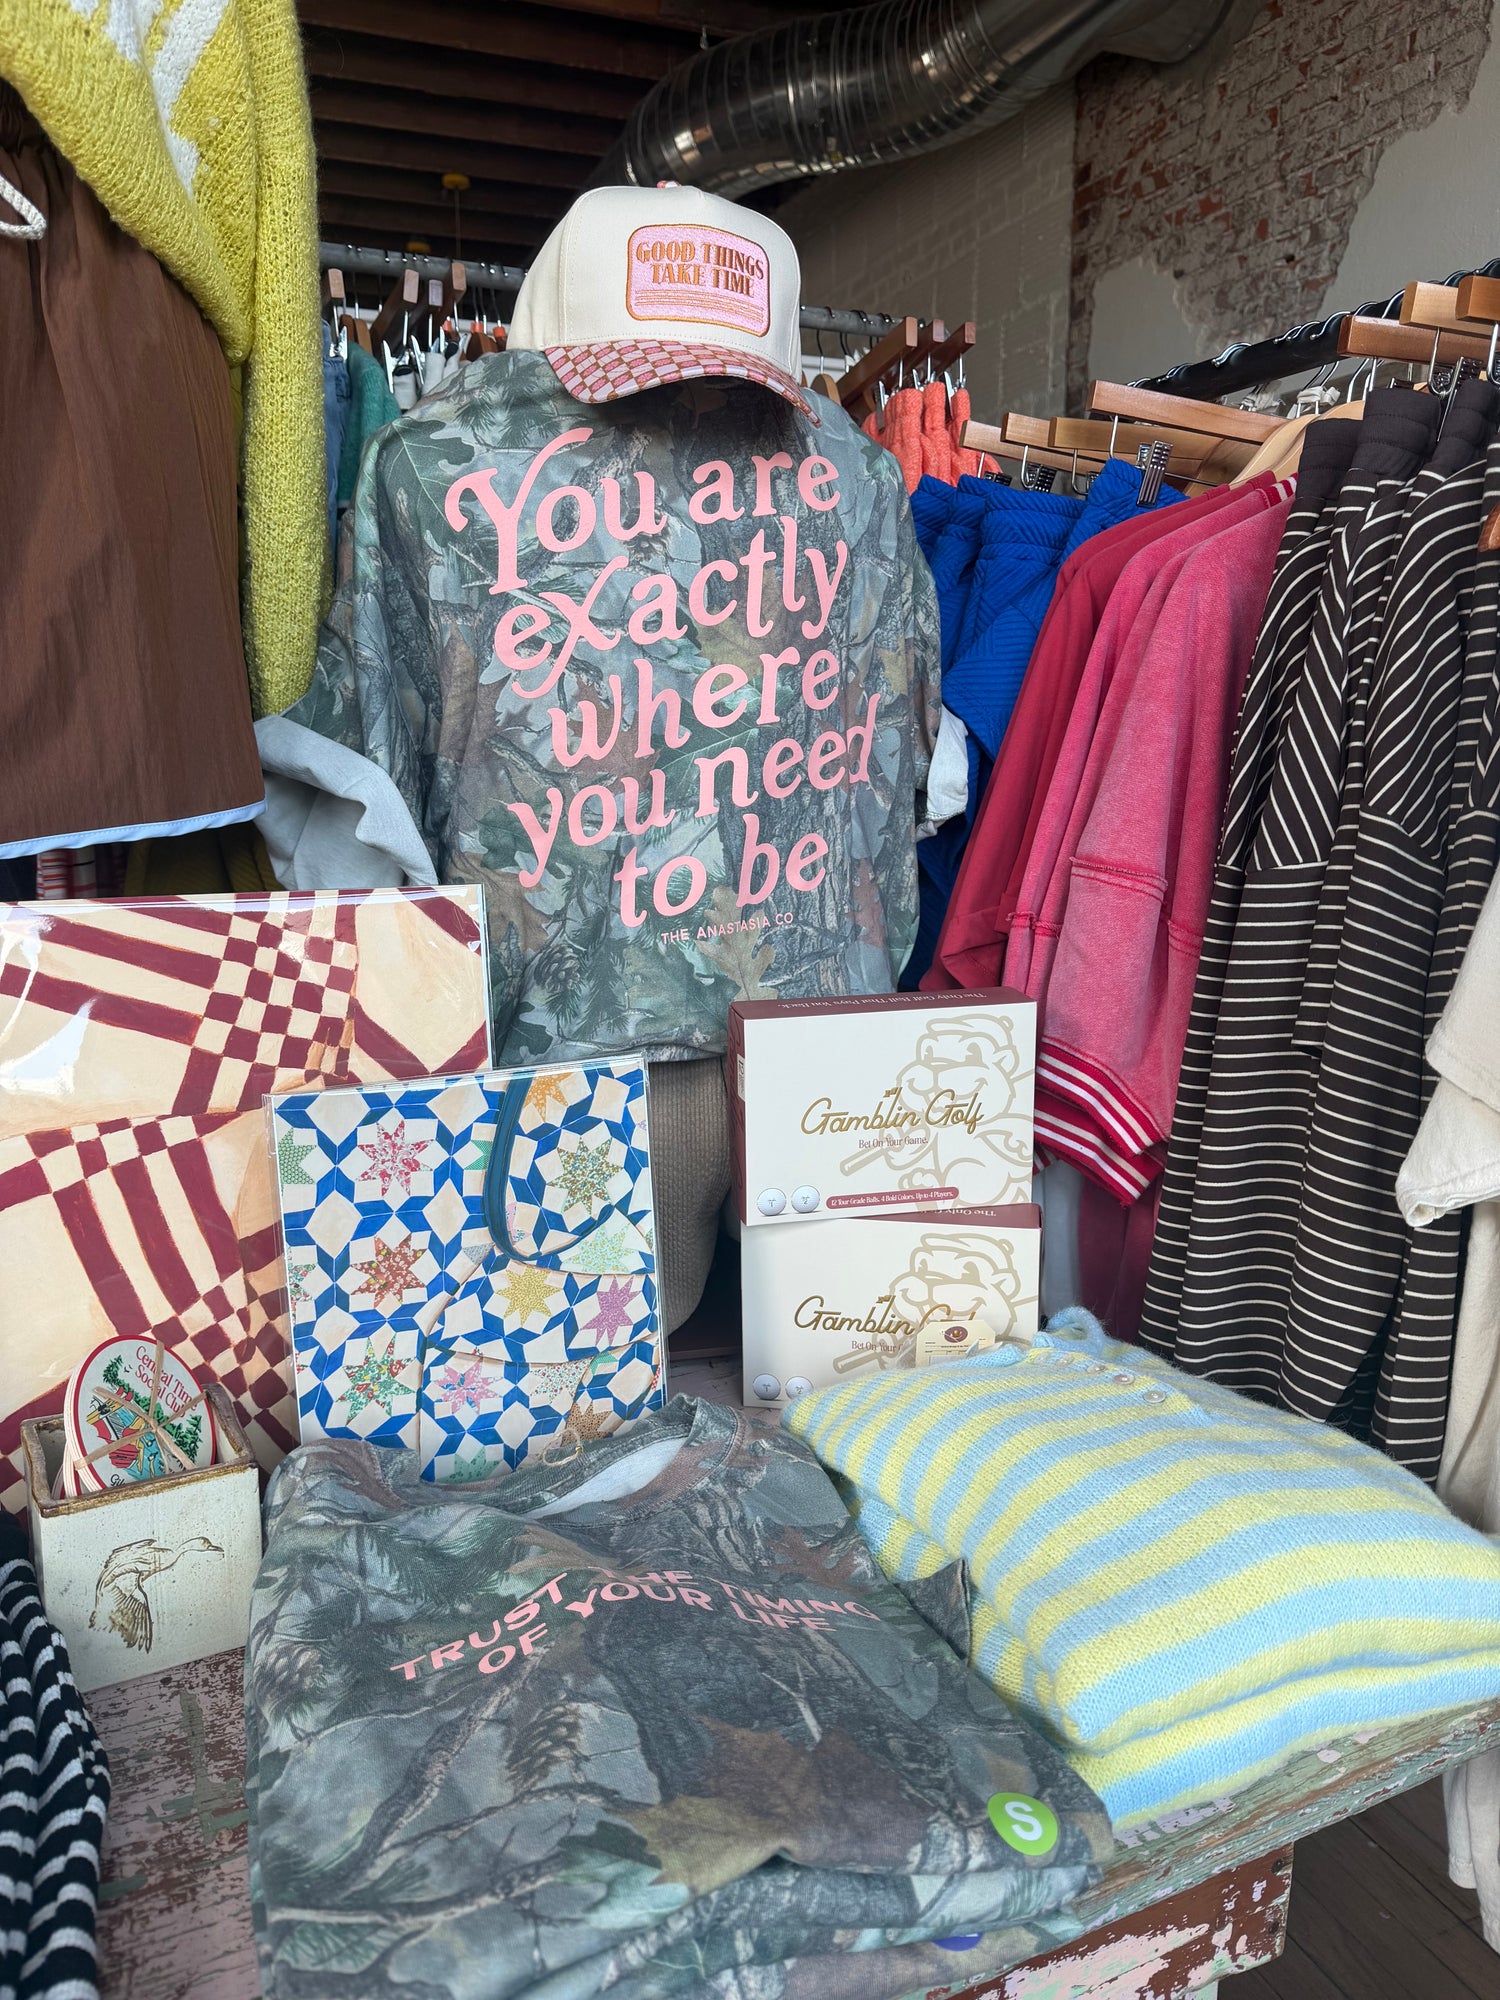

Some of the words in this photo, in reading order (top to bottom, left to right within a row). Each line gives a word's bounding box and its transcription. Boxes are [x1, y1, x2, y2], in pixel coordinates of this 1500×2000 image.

[636, 241, 696, 264] GOOD
[702, 243, 764, 280] THINGS
[650, 263, 706, 286] TAKE
[712, 268, 755, 298] TIME
[445, 427, 669, 595] You
[687, 451, 841, 525] are
[494, 515, 848, 699] exactly
[547, 646, 840, 767] where
[507, 768, 676, 888] you
[694, 694, 880, 819] need
[613, 846, 707, 927] to
[736, 813, 829, 908] be
[661, 928, 690, 945] THE
[696, 916, 771, 939] ANASTASIA
[775, 912, 794, 926] CO
[800, 1086, 921, 1135] Gamblin
[925, 1089, 985, 1134] Golf
[858, 1139, 871, 1148] Bet
[872, 1138, 884, 1147] On
[886, 1137, 903, 1146] Your
[904, 1136, 929, 1145] Game.
[838, 1198, 849, 1206] Tour
[850, 1197, 866, 1205] Grade
[886, 1194, 897, 1202] Bold
[973, 1208, 997, 1217] The
[794, 1294, 915, 1336] Gamblin
[136, 1345, 173, 1387] Cenal
[851, 1340, 864, 1350] Bet
[865, 1341, 877, 1351] On
[879, 1342, 897, 1352] Your
[390, 1572, 568, 1680] TRUST
[587, 1566, 699, 1585] THE
[702, 1576, 881, 1622] TIMING
[478, 1622, 548, 1674] OF
[565, 1582, 714, 1619] YOUR
[729, 1600, 837, 1632] LIFE
[1004, 1801, 1043, 1841] S
